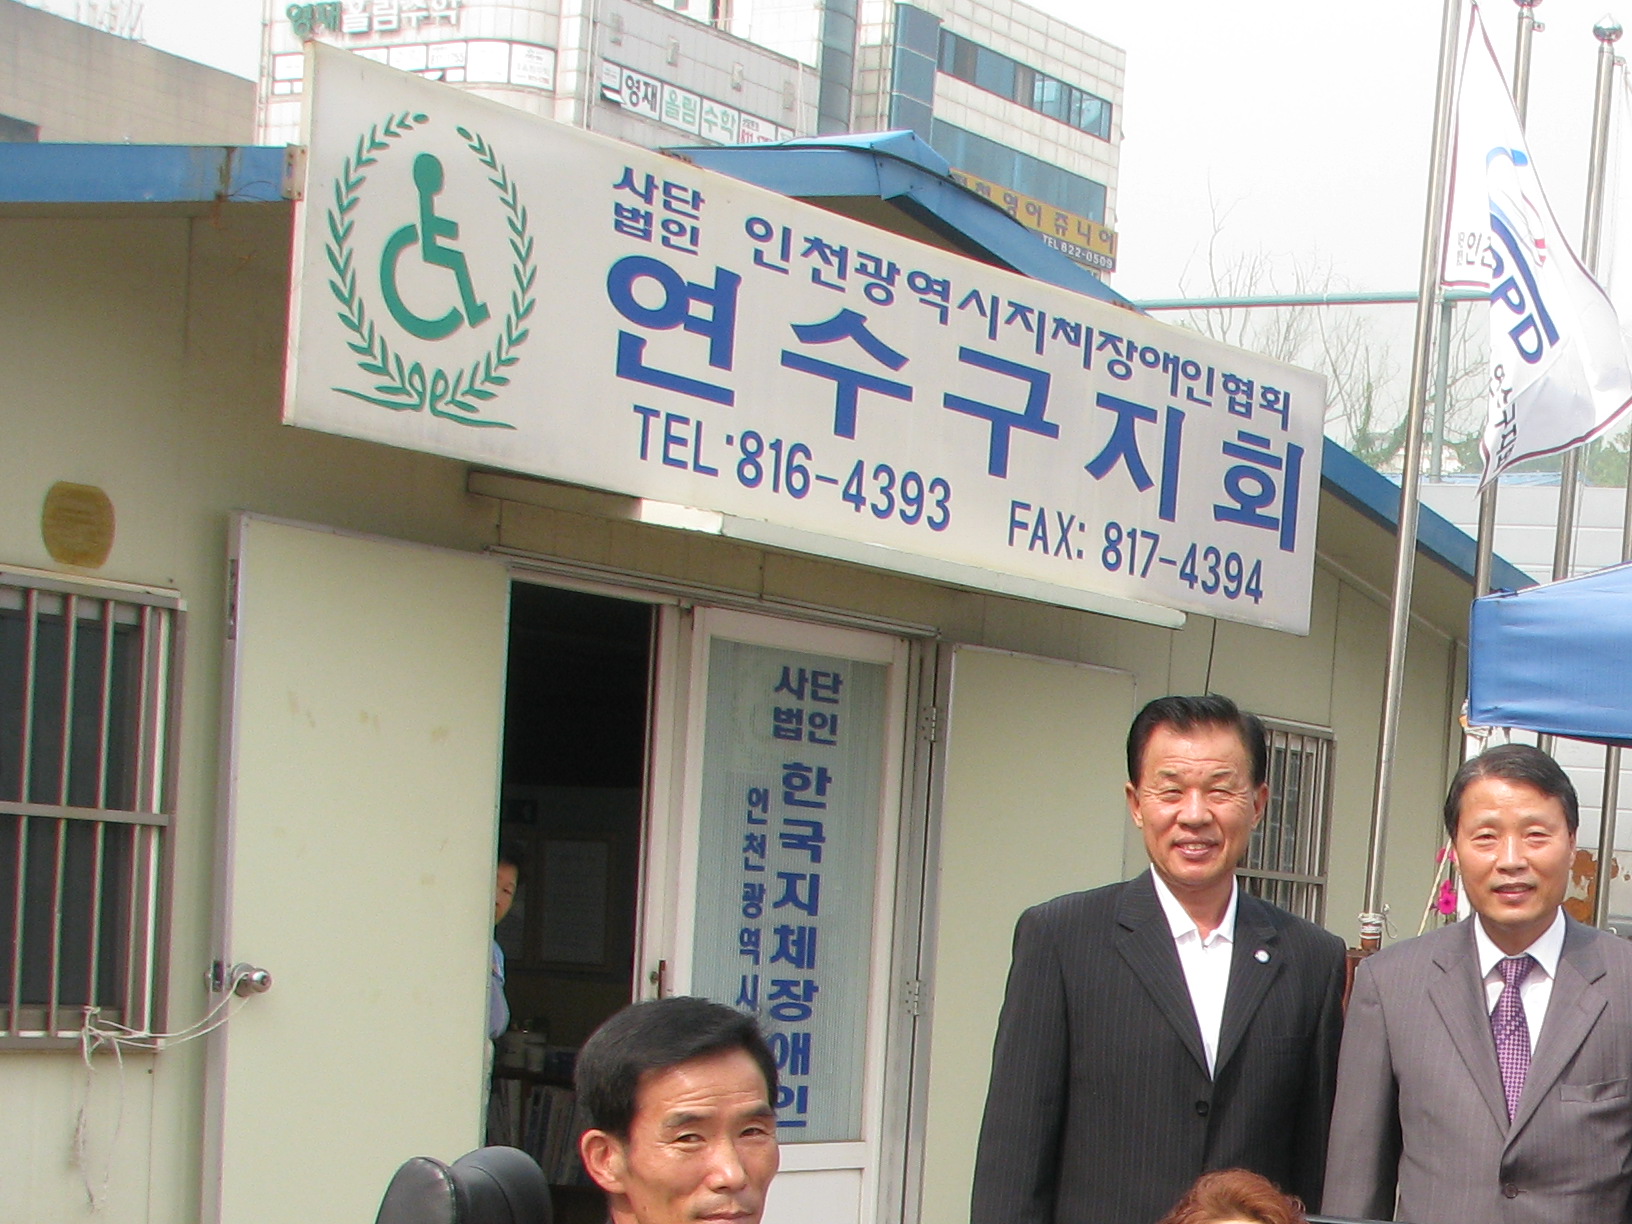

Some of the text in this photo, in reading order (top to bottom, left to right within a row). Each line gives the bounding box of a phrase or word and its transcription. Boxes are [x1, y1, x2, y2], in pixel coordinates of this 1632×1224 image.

[625, 74, 657, 114] 영재
[613, 166, 705, 220] 사단
[613, 202, 699, 256] 법인
[1042, 233, 1113, 270] TEL 822-0509
[607, 254, 1305, 553] 연수구지회
[1100, 521, 1264, 605] 817-4394
[774, 665, 844, 704] 사단
[773, 706, 838, 746] 법인
[766, 761, 833, 1128] 한국지체장애인
